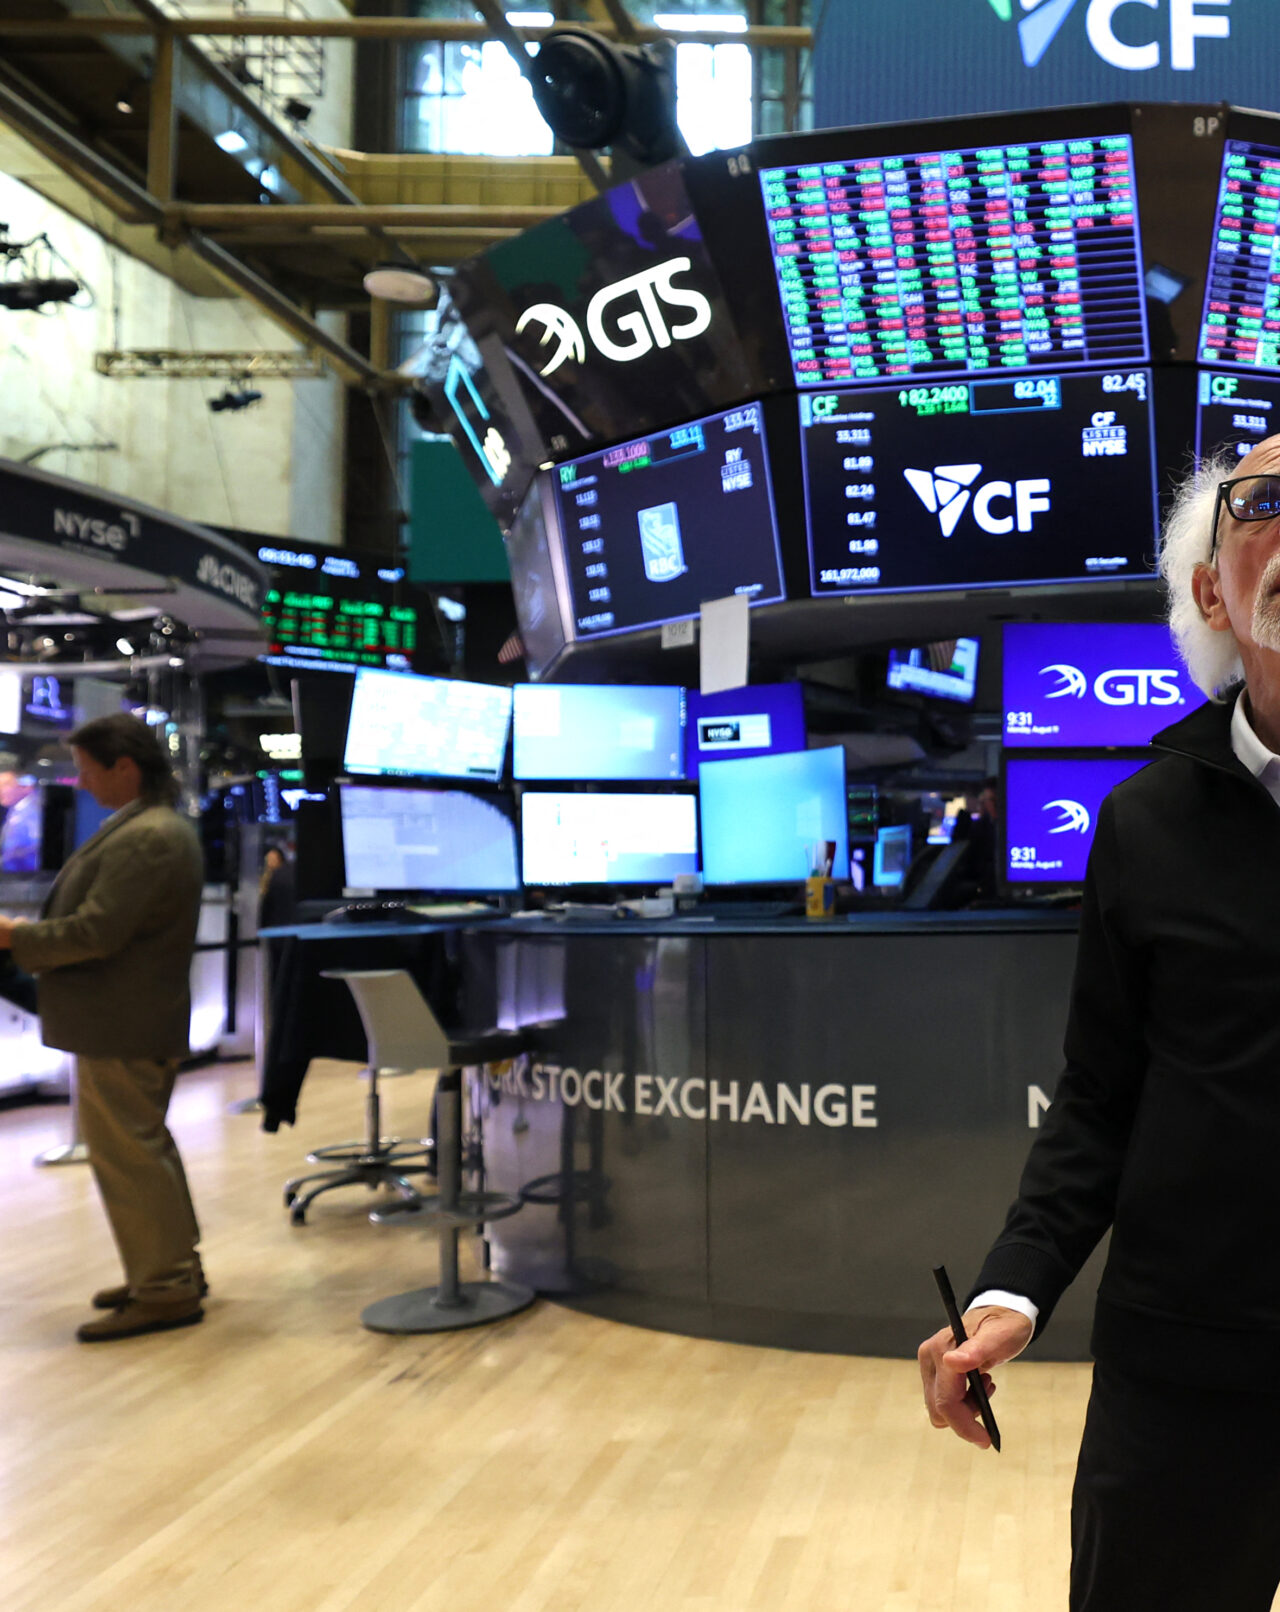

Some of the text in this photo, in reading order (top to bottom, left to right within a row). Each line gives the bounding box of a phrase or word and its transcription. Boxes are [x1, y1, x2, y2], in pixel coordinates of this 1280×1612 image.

[1086, 0, 1230, 71] CF
[587, 257, 712, 363] GTS
[1014, 380, 1057, 399] 82.04
[1102, 373, 1146, 393] 82.45
[1212, 377, 1238, 396] CF
[908, 385, 969, 406] 82.2400
[812, 395, 839, 416] CF
[1091, 411, 1116, 428] CF
[1082, 428, 1126, 440] LISTED
[1082, 440, 1127, 456] NYSE
[972, 478, 1051, 535] CF
[1007, 712, 1032, 725] 9:31
[1011, 847, 1036, 861] 9:31
[531, 1063, 626, 1112] STOCK
[634, 1074, 878, 1128] EXCHANGE
